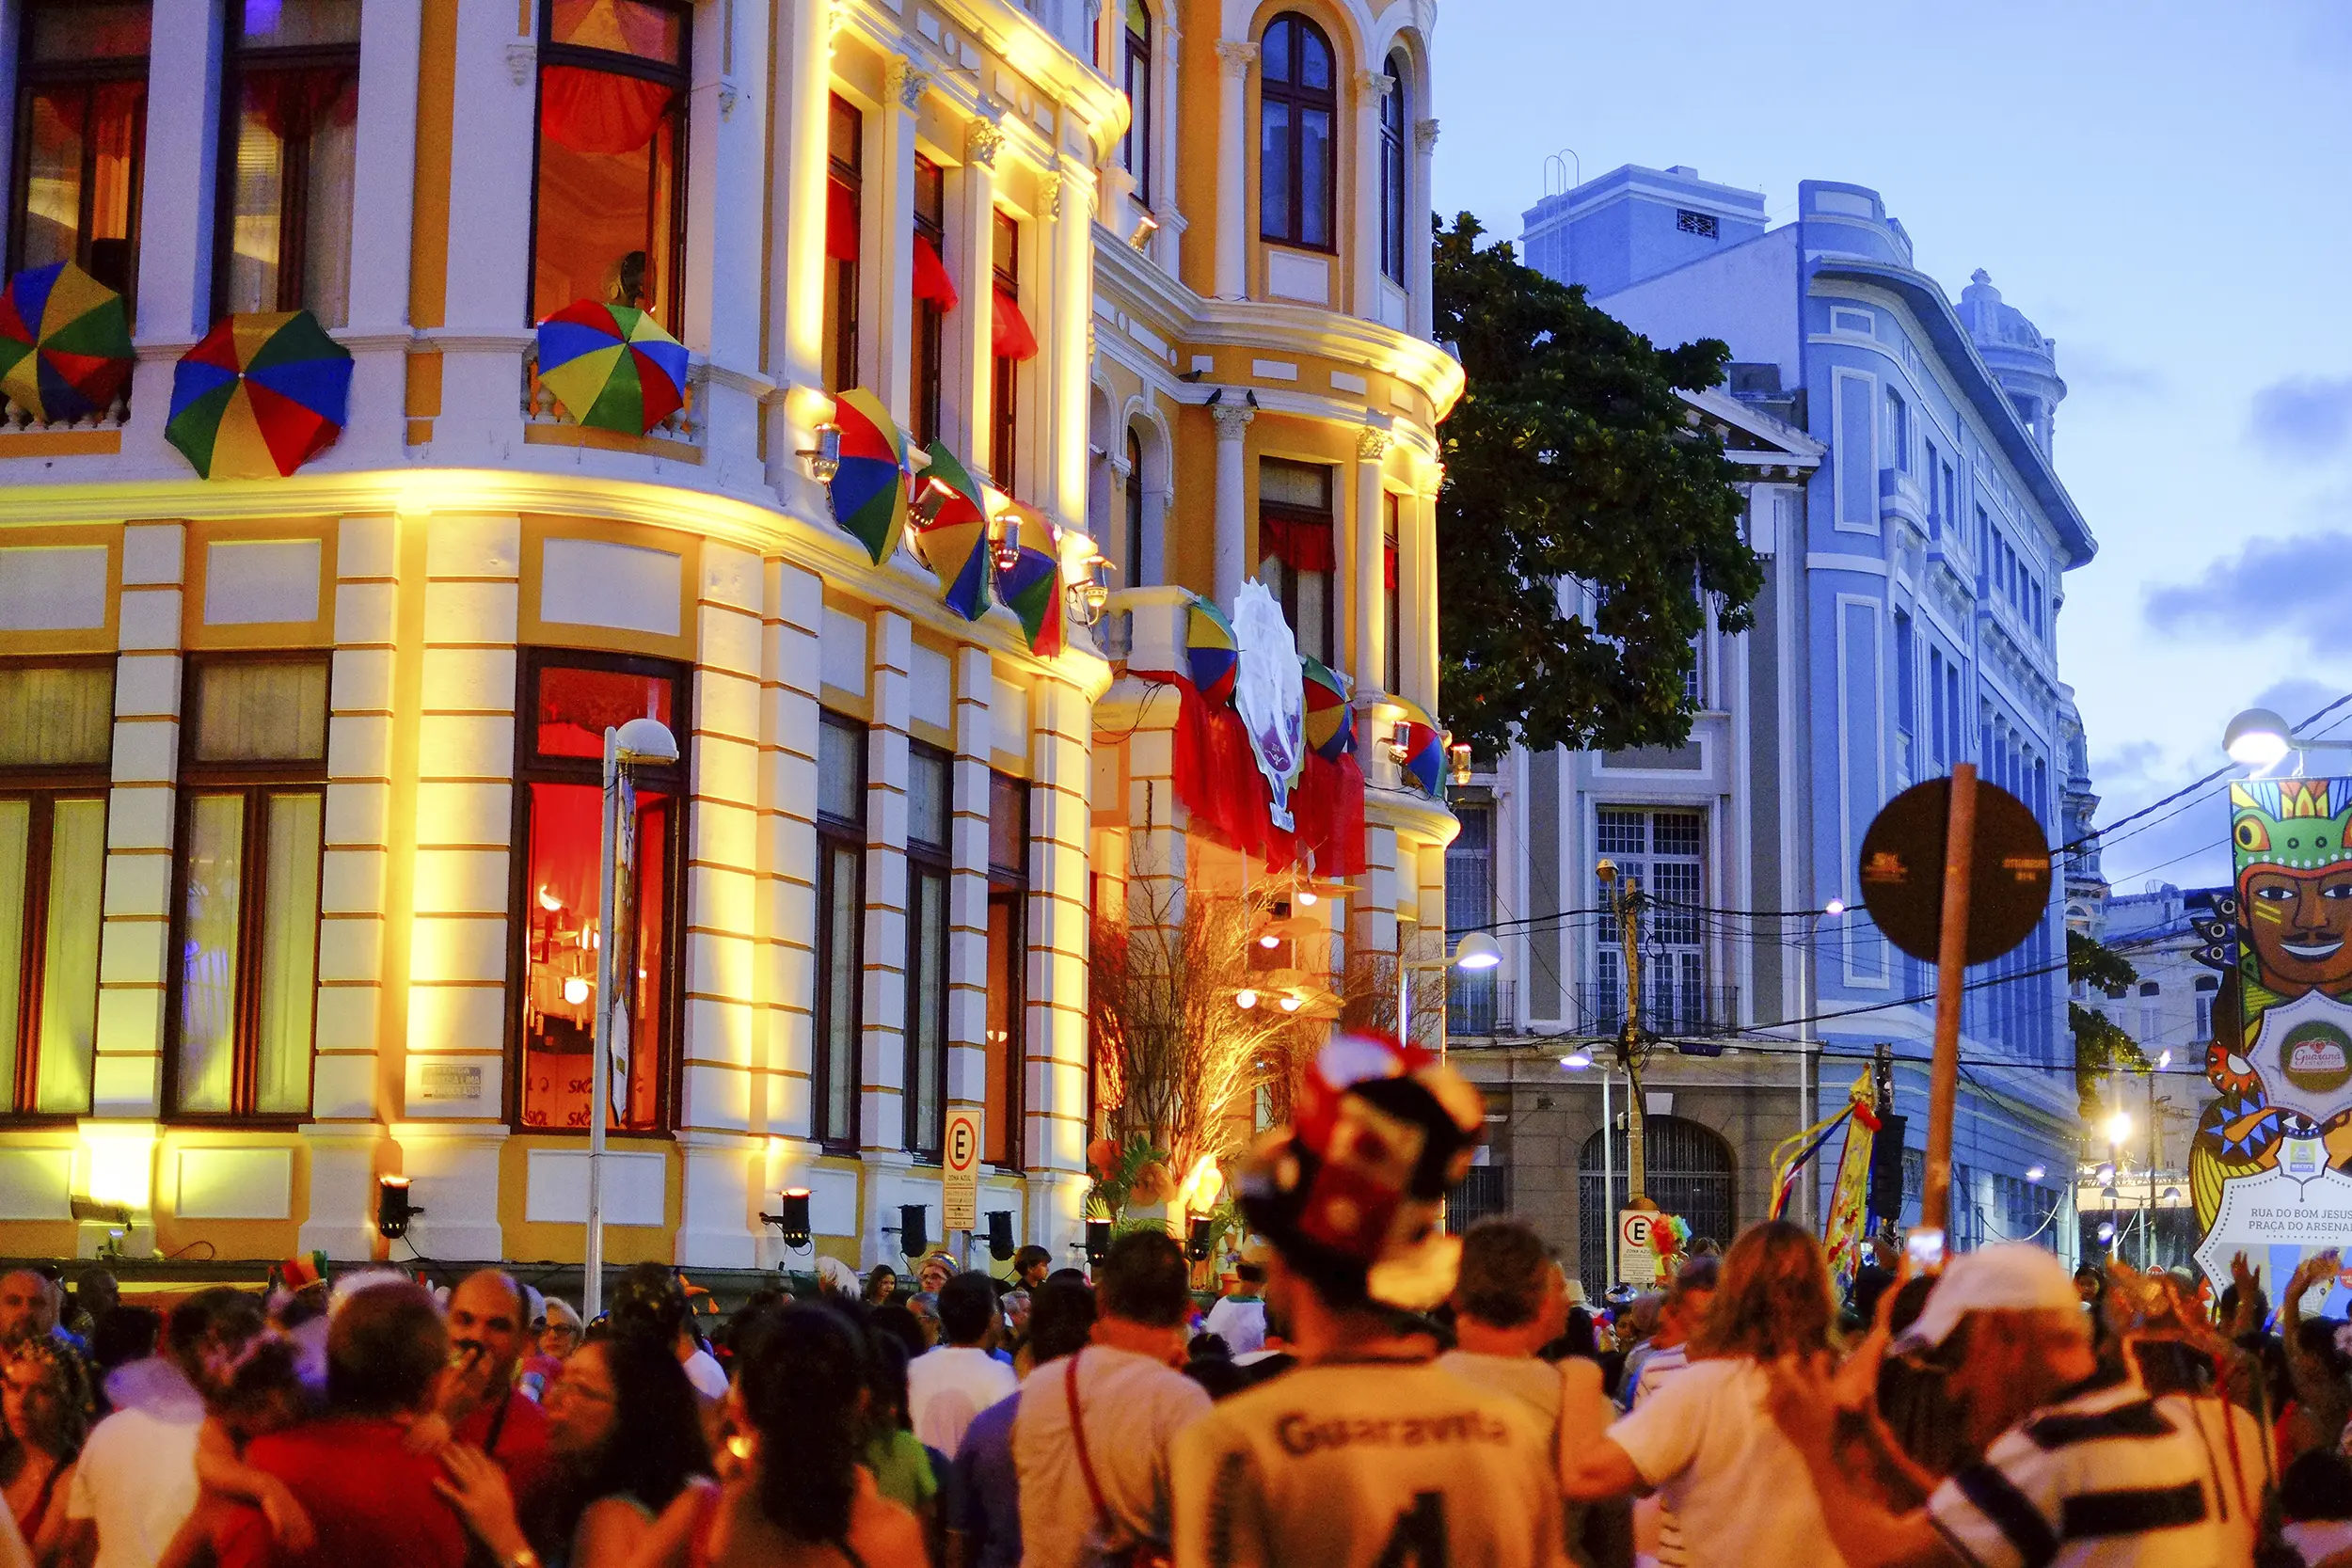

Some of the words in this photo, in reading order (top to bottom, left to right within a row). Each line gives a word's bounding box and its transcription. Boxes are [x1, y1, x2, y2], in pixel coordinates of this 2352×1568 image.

[568, 1077, 593, 1093] SK
[566, 1110, 592, 1127] SK
[956, 1130, 966, 1160] E
[2251, 1209, 2273, 1217] RUA
[2276, 1209, 2292, 1217] DO
[2294, 1209, 2318, 1218] BOM
[2321, 1210, 2352, 1219] JESUS
[1634, 1223, 1645, 1240] E
[2249, 1221, 2285, 1232] PRAÇA
[2287, 1222, 2303, 1230] DO
